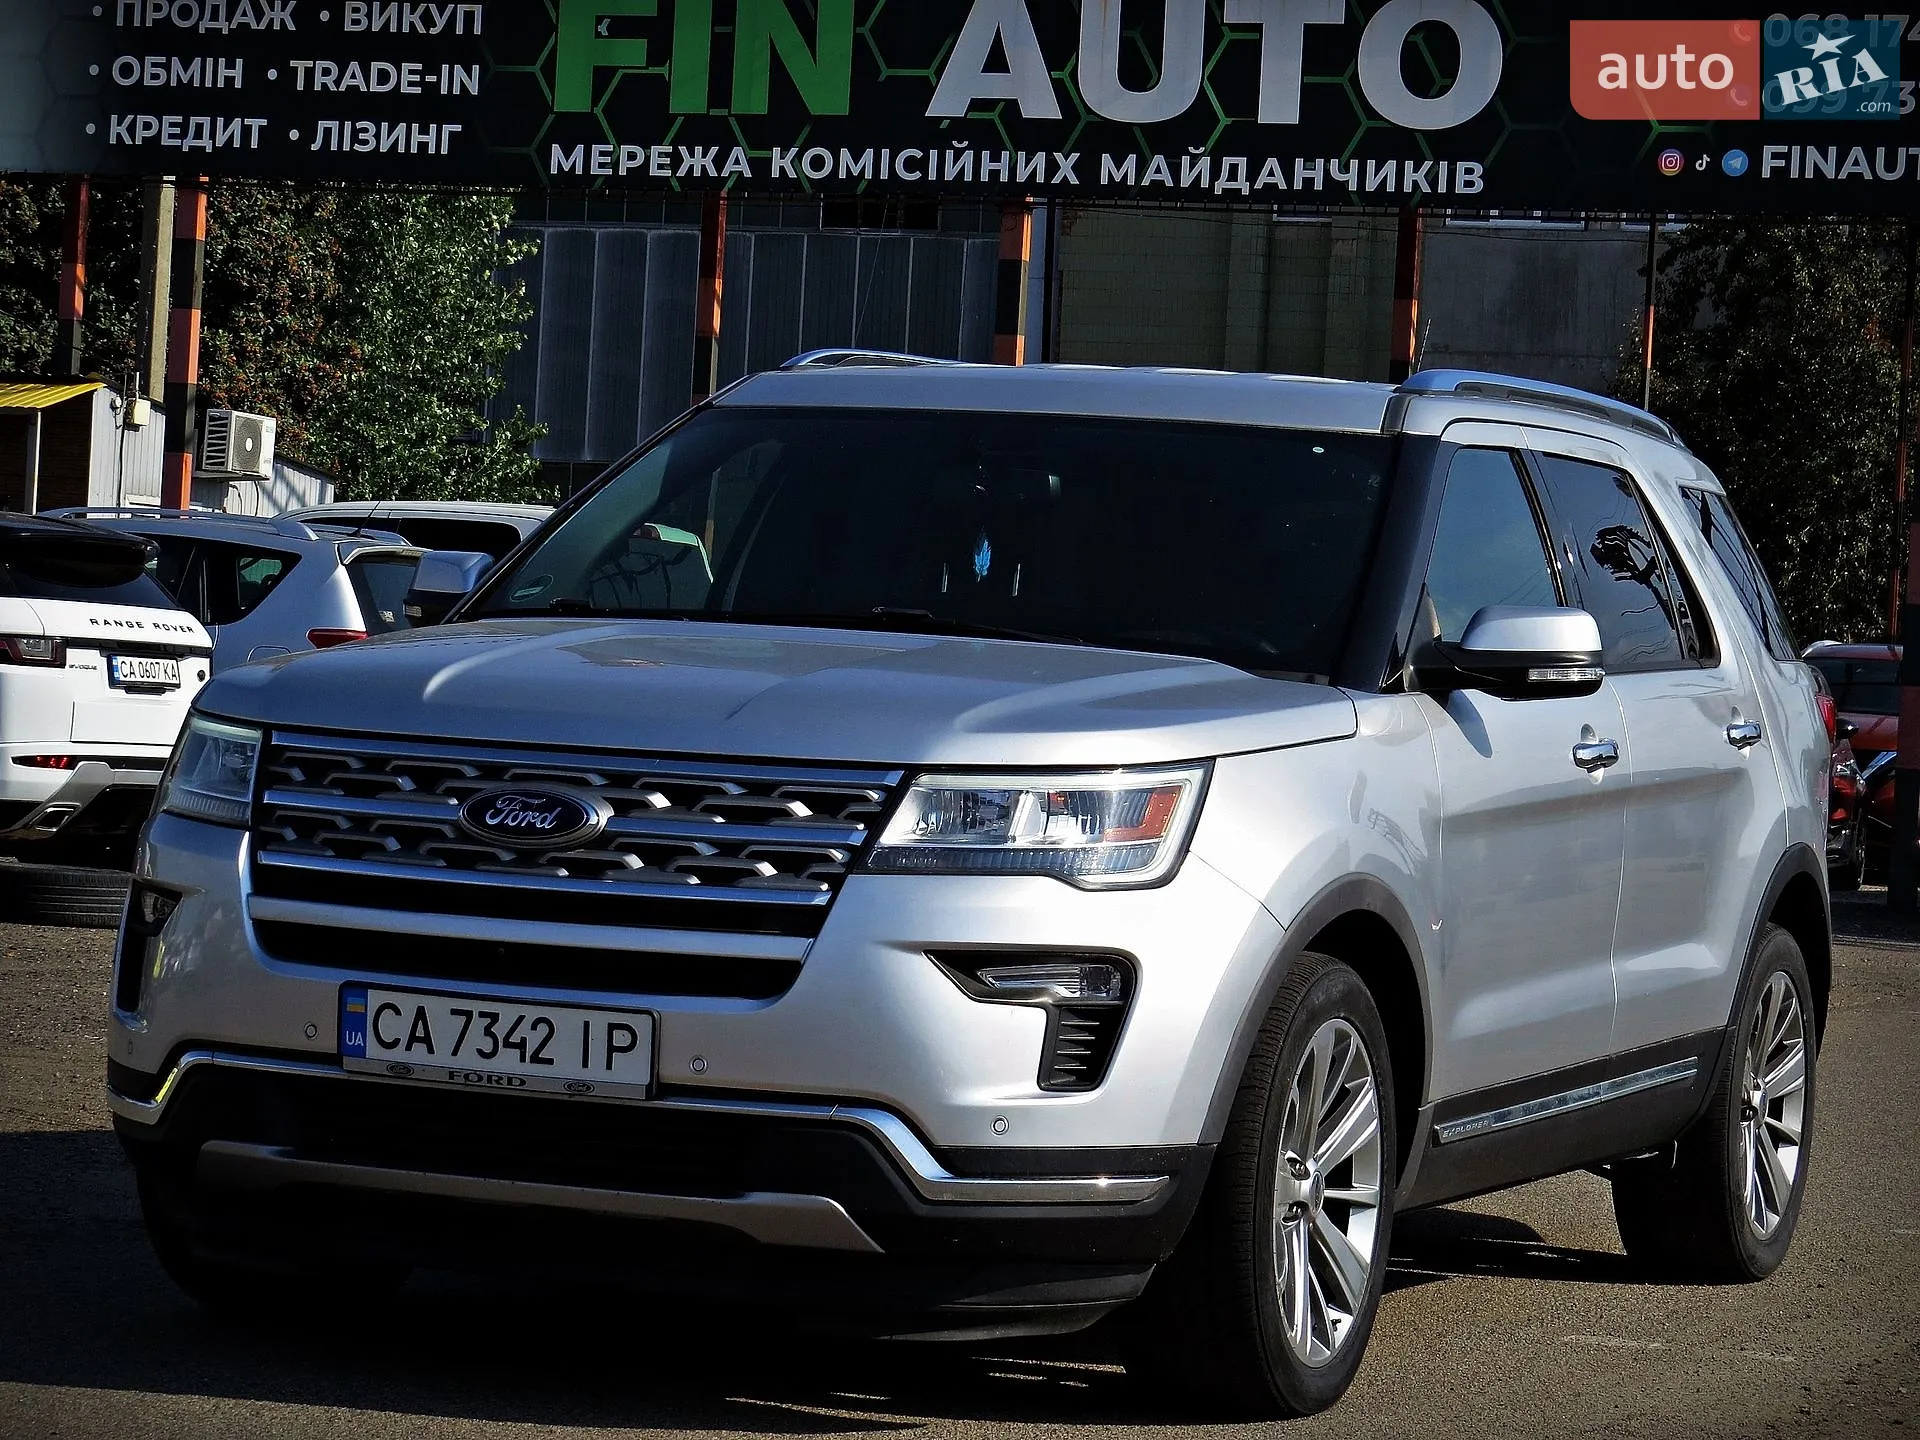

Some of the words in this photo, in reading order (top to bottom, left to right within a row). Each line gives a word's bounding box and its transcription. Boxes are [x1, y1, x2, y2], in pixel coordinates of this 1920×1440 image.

[115, 0, 297, 34] ПРОДАЖ
[344, 1, 482, 35] ВИКУП
[112, 56, 243, 89] ОБМІН
[290, 60, 480, 96] TRADE-IN
[553, 0, 853, 115] FIN
[924, 0, 1503, 130] AUTO
[1862, 81, 1920, 114] 73
[109, 115, 267, 152] КРЕДИТ
[311, 121, 462, 155] ЛІЗИНГ
[550, 144, 752, 178] МЕРЕЖА
[771, 140, 1079, 185] КОМІСІЙНИХ
[1100, 146, 1485, 195] МАЙДАНЧИКІВ
[89, 618, 145, 629] RANGE
[152, 622, 195, 634] ROVER
[120, 660, 137, 679] CA
[138, 661, 161, 680] 0607
[163, 662, 178, 681] KA
[485, 795, 562, 829] Ford
[345, 1030, 365, 1048] UA
[372, 1001, 437, 1056] CA
[449, 1008, 556, 1066] 7342
[580, 1019, 639, 1071] IP
[448, 1070, 527, 1088] FORD
